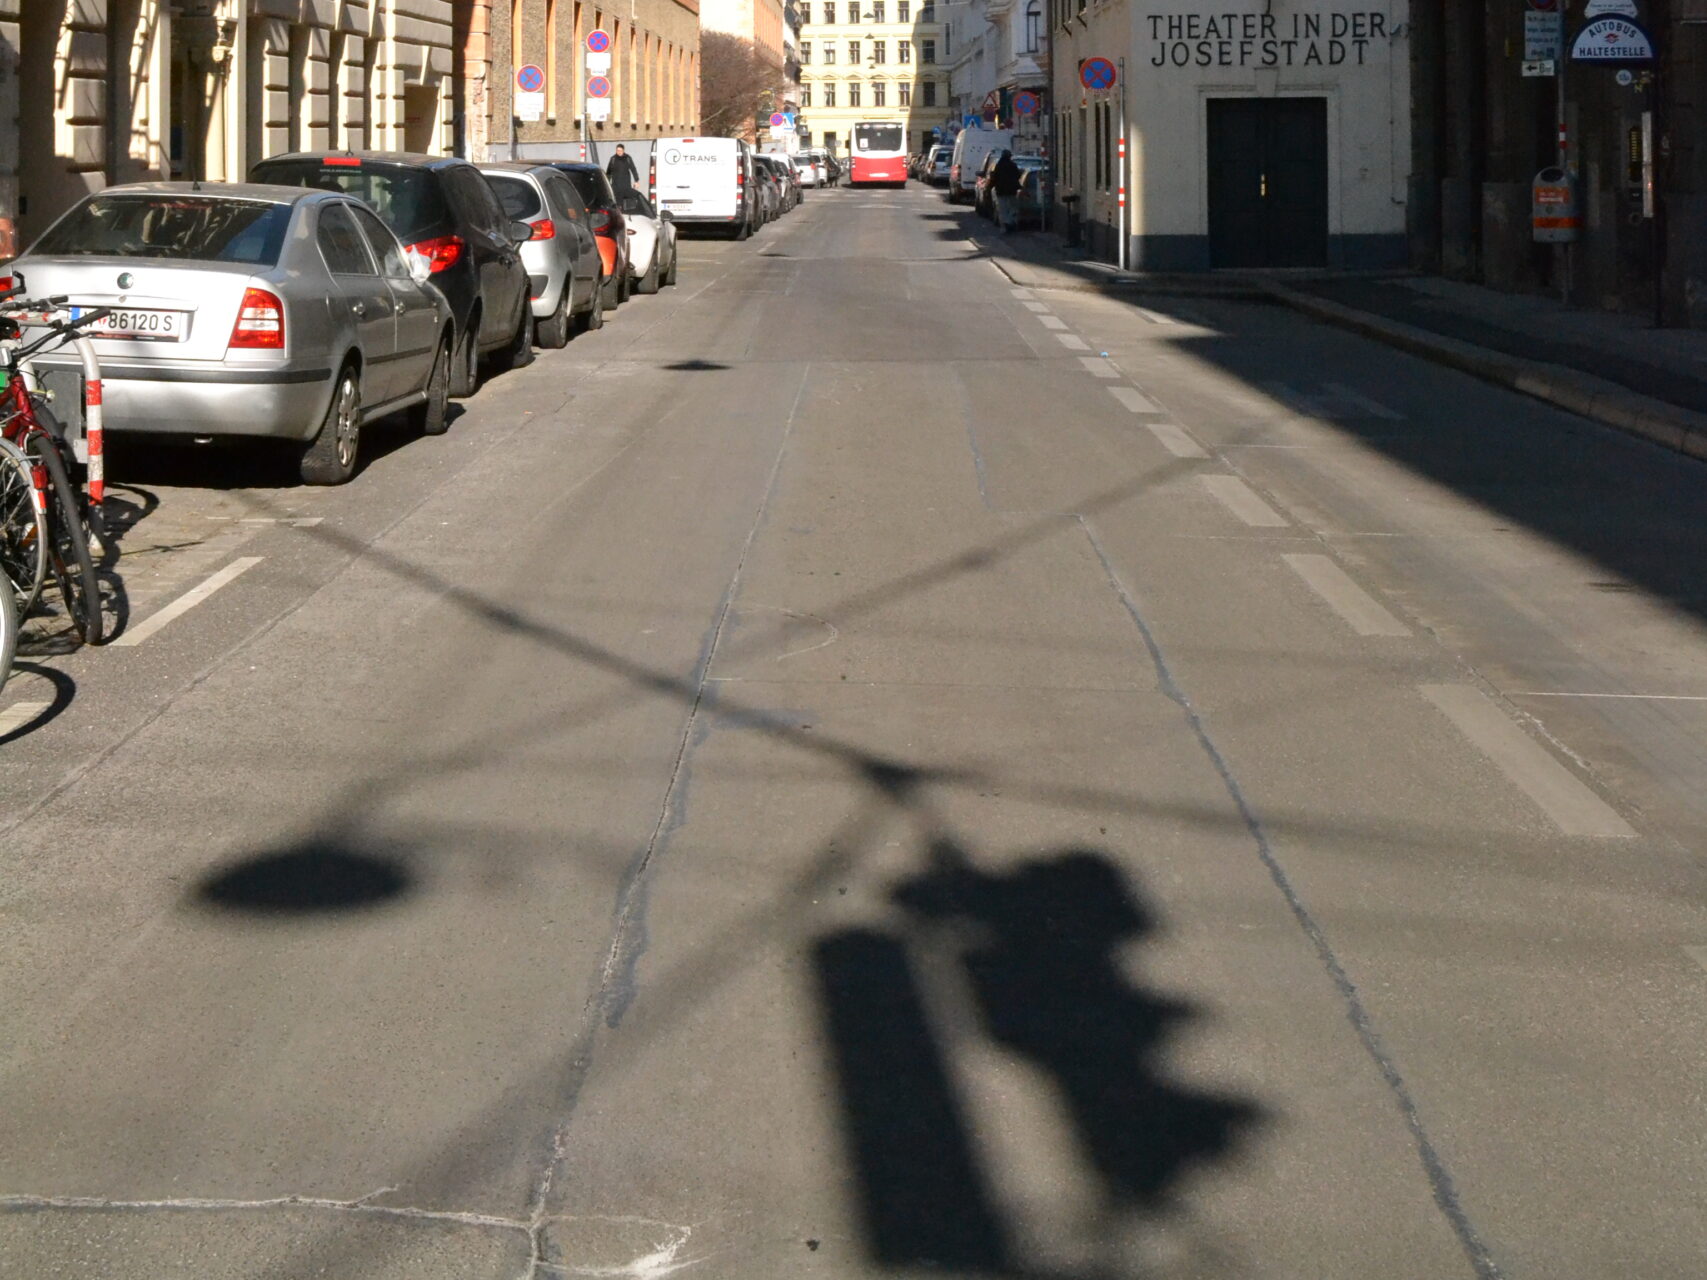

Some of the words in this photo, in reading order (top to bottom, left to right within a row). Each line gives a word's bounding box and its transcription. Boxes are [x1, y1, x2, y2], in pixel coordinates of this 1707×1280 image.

[1147, 13, 1275, 40] THEATER
[1293, 13, 1321, 39] IN
[1332, 13, 1386, 39] DER
[1588, 21, 1637, 38] AUTOBUS
[1151, 40, 1370, 67] JOSEFSTADT
[1579, 46, 1645, 57] HALTESTELLE
[682, 154, 717, 162] TRANS
[108, 312, 158, 331] 86120
[163, 315, 173, 332] S
